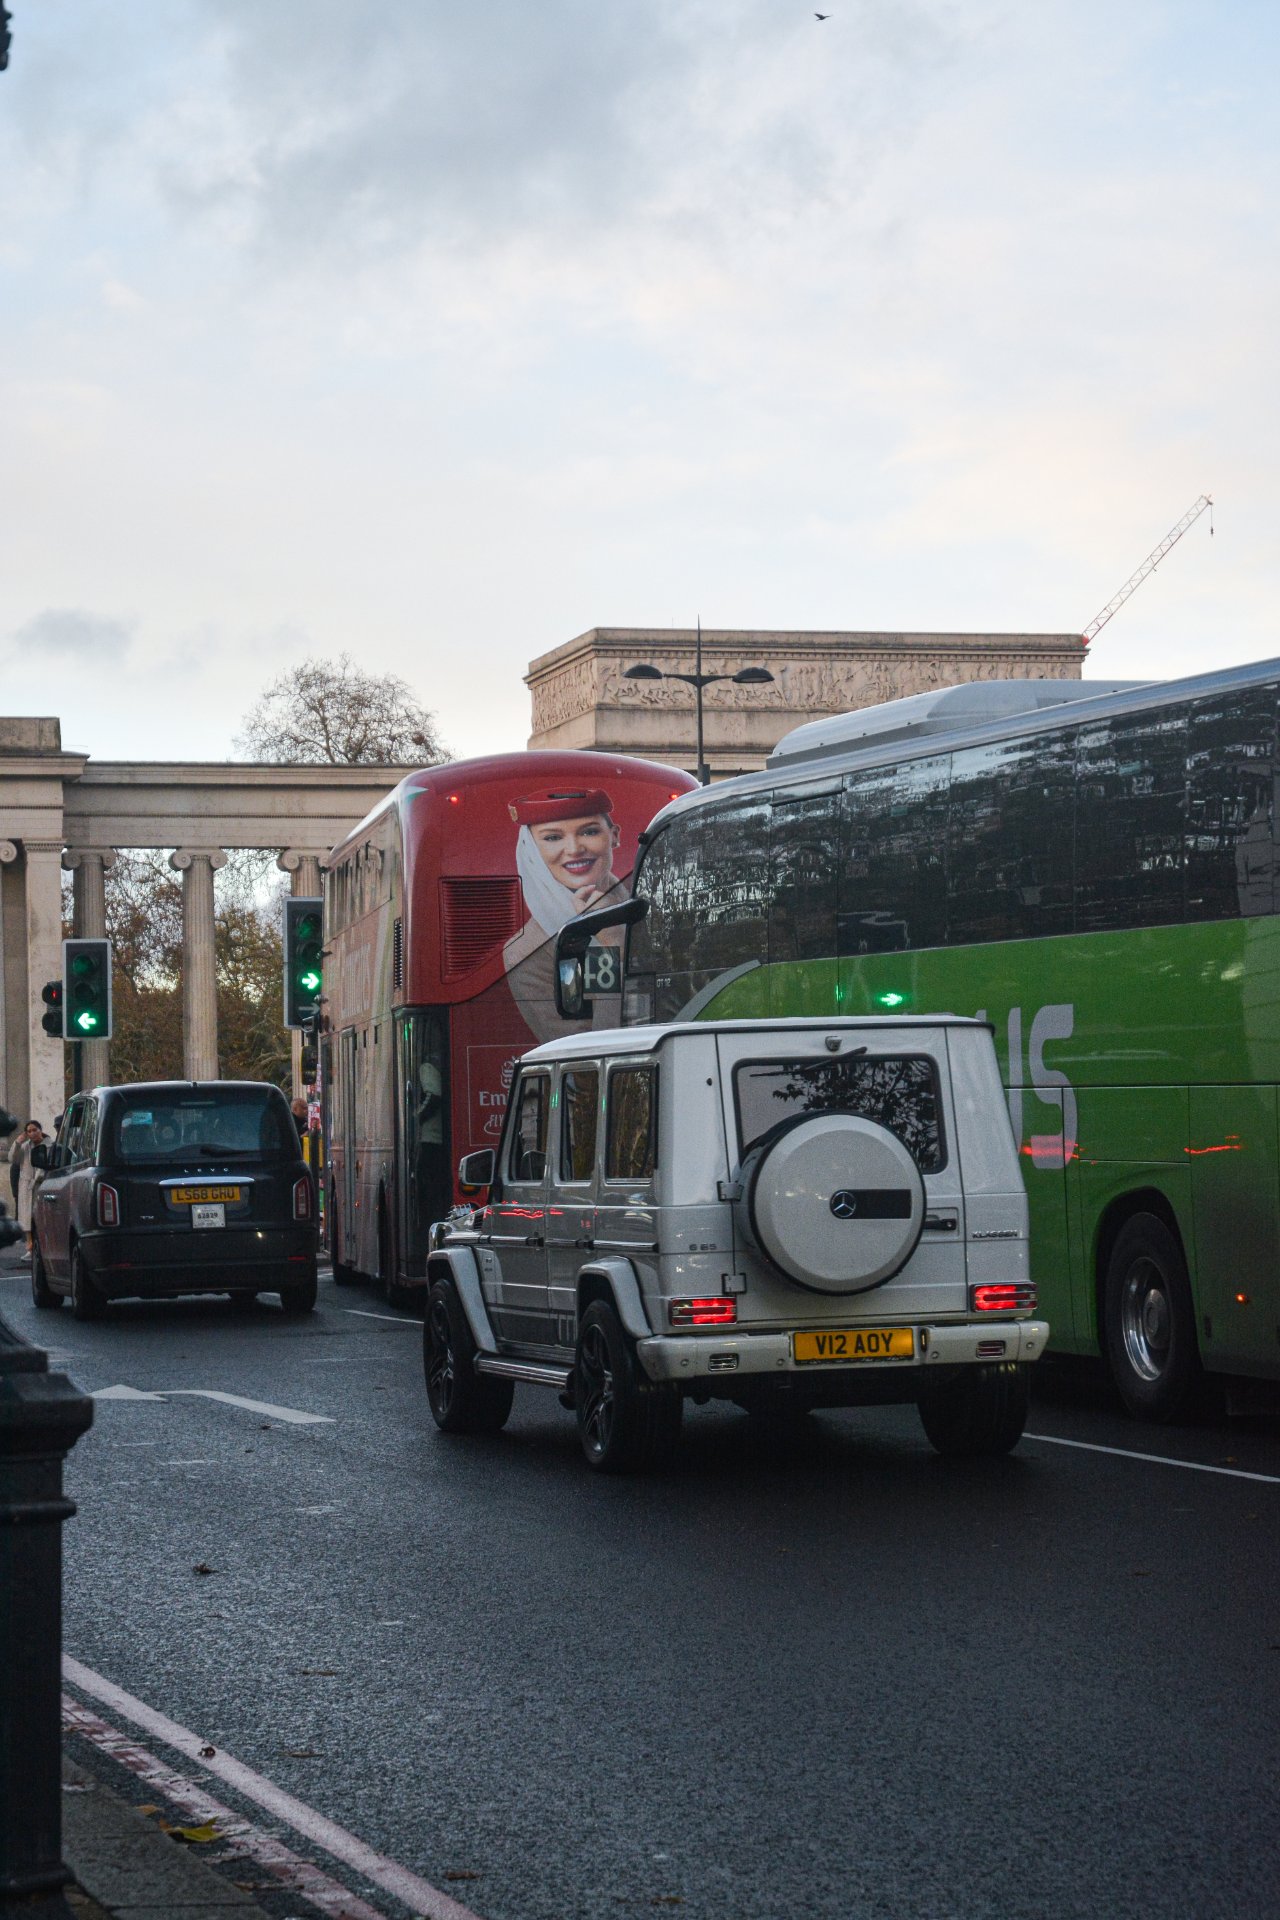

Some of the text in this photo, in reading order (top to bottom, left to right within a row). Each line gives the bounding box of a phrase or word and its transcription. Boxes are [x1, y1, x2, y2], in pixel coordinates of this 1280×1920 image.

[479, 1090, 510, 1106] Em
[176, 1189, 209, 1201] LS68
[815, 1332, 894, 1356] V12 AOY
